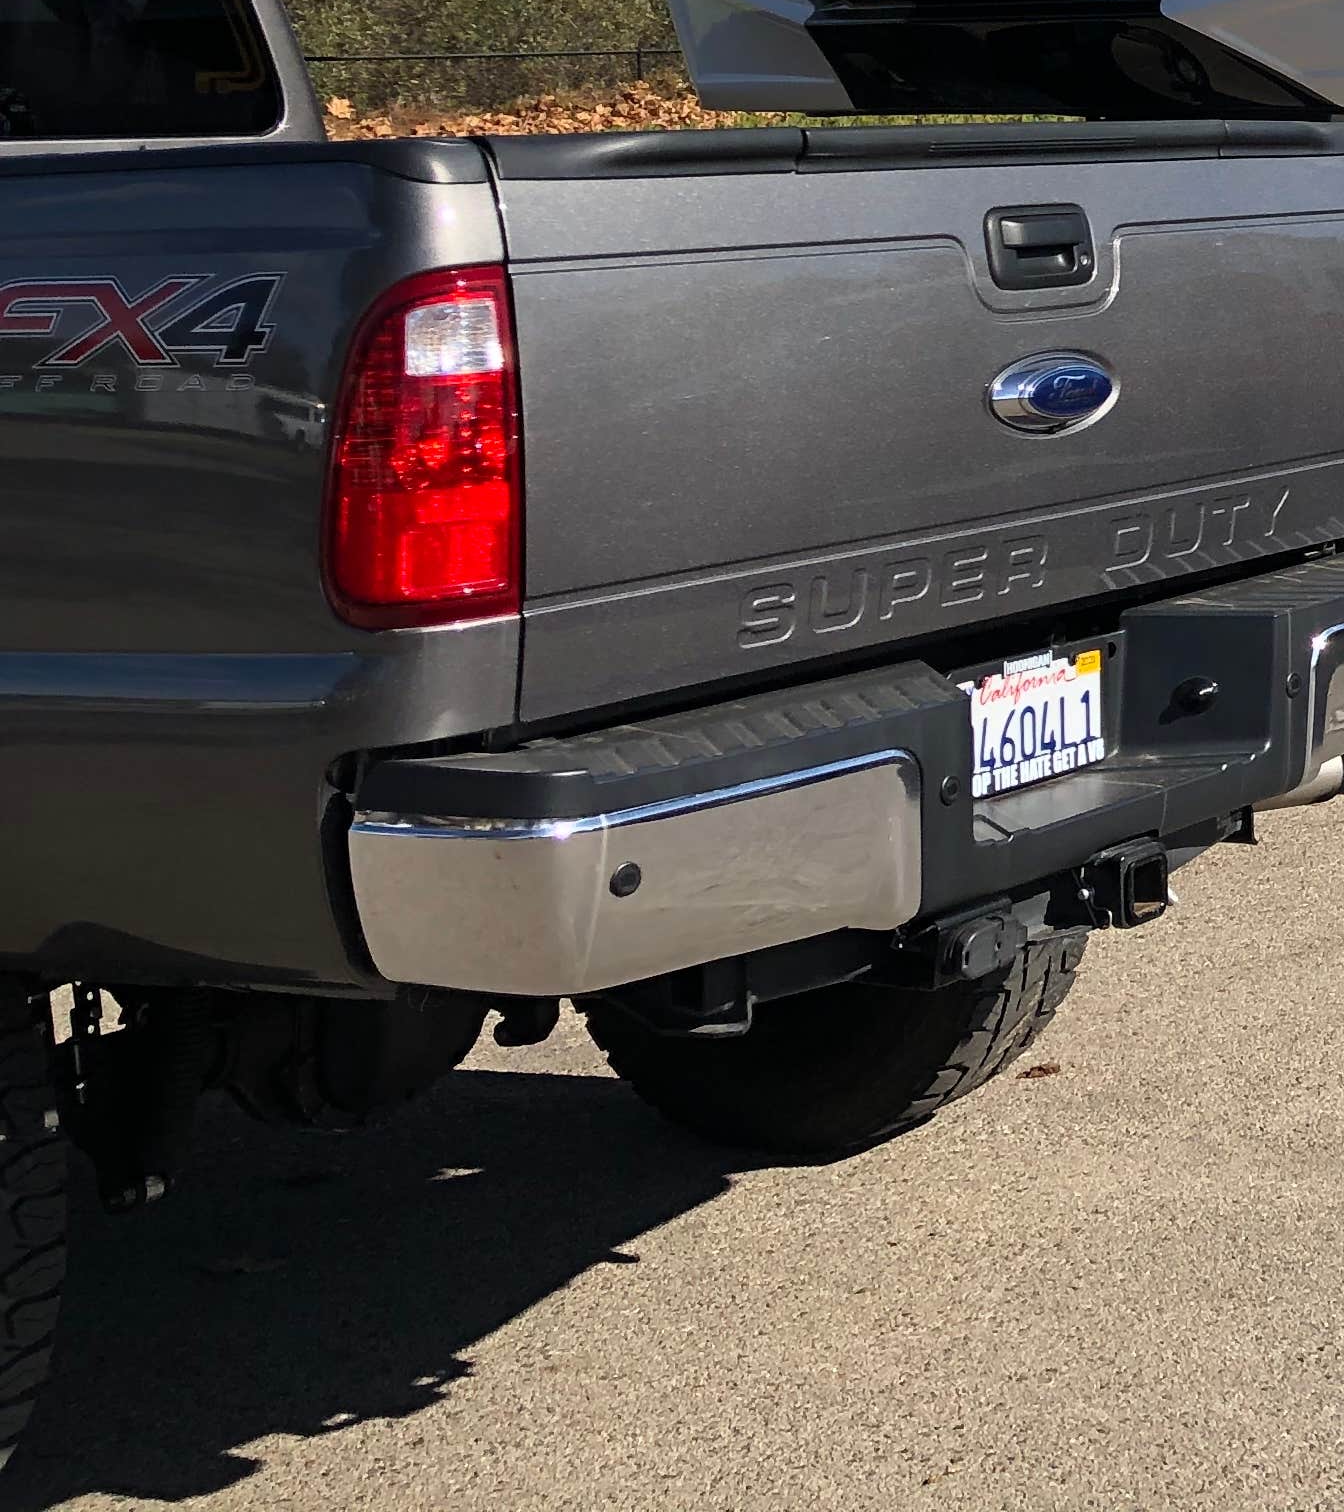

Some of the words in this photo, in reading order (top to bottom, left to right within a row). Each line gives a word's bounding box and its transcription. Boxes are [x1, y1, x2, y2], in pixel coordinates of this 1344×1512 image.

[90, 374, 255, 393] ROAD
[737, 533, 1048, 649] SUPER
[1101, 484, 1291, 574] DUTY
[979, 666, 1077, 706] California
[979, 690, 1099, 769] 4604L1
[993, 763, 1019, 792] THE
[1019, 754, 1052, 784] HATE
[1053, 746, 1076, 774] GET
[1077, 742, 1087, 767] A
